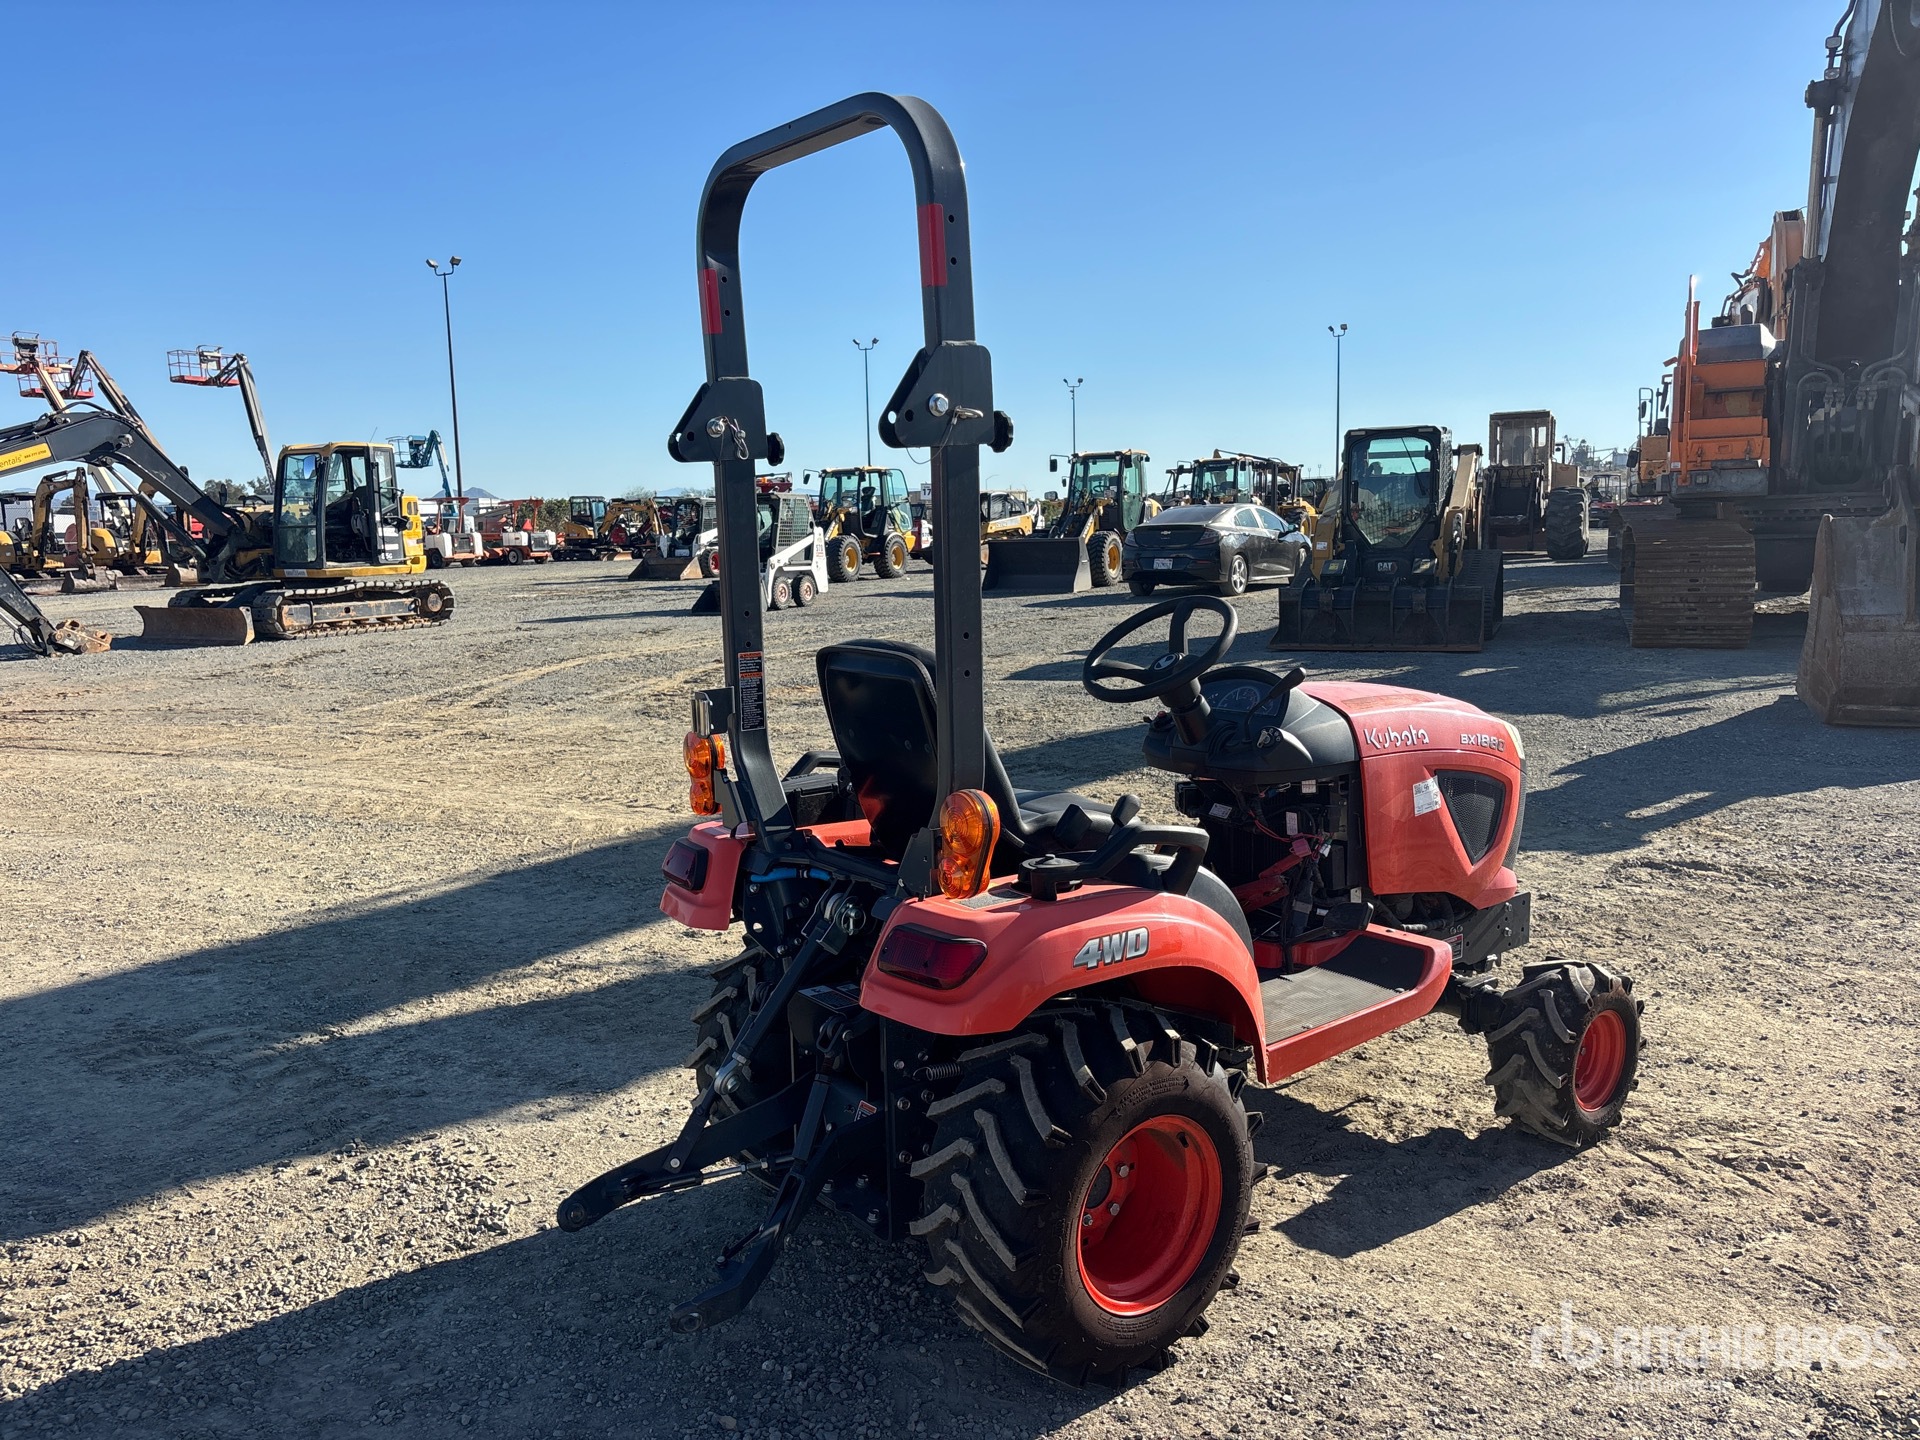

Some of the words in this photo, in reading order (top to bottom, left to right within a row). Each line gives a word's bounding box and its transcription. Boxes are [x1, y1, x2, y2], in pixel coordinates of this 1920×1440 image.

[922, 488, 932, 496] 17
[1377, 562, 1393, 572] CAT
[1363, 724, 1430, 749] Kubota
[1073, 926, 1149, 970] 4WD
